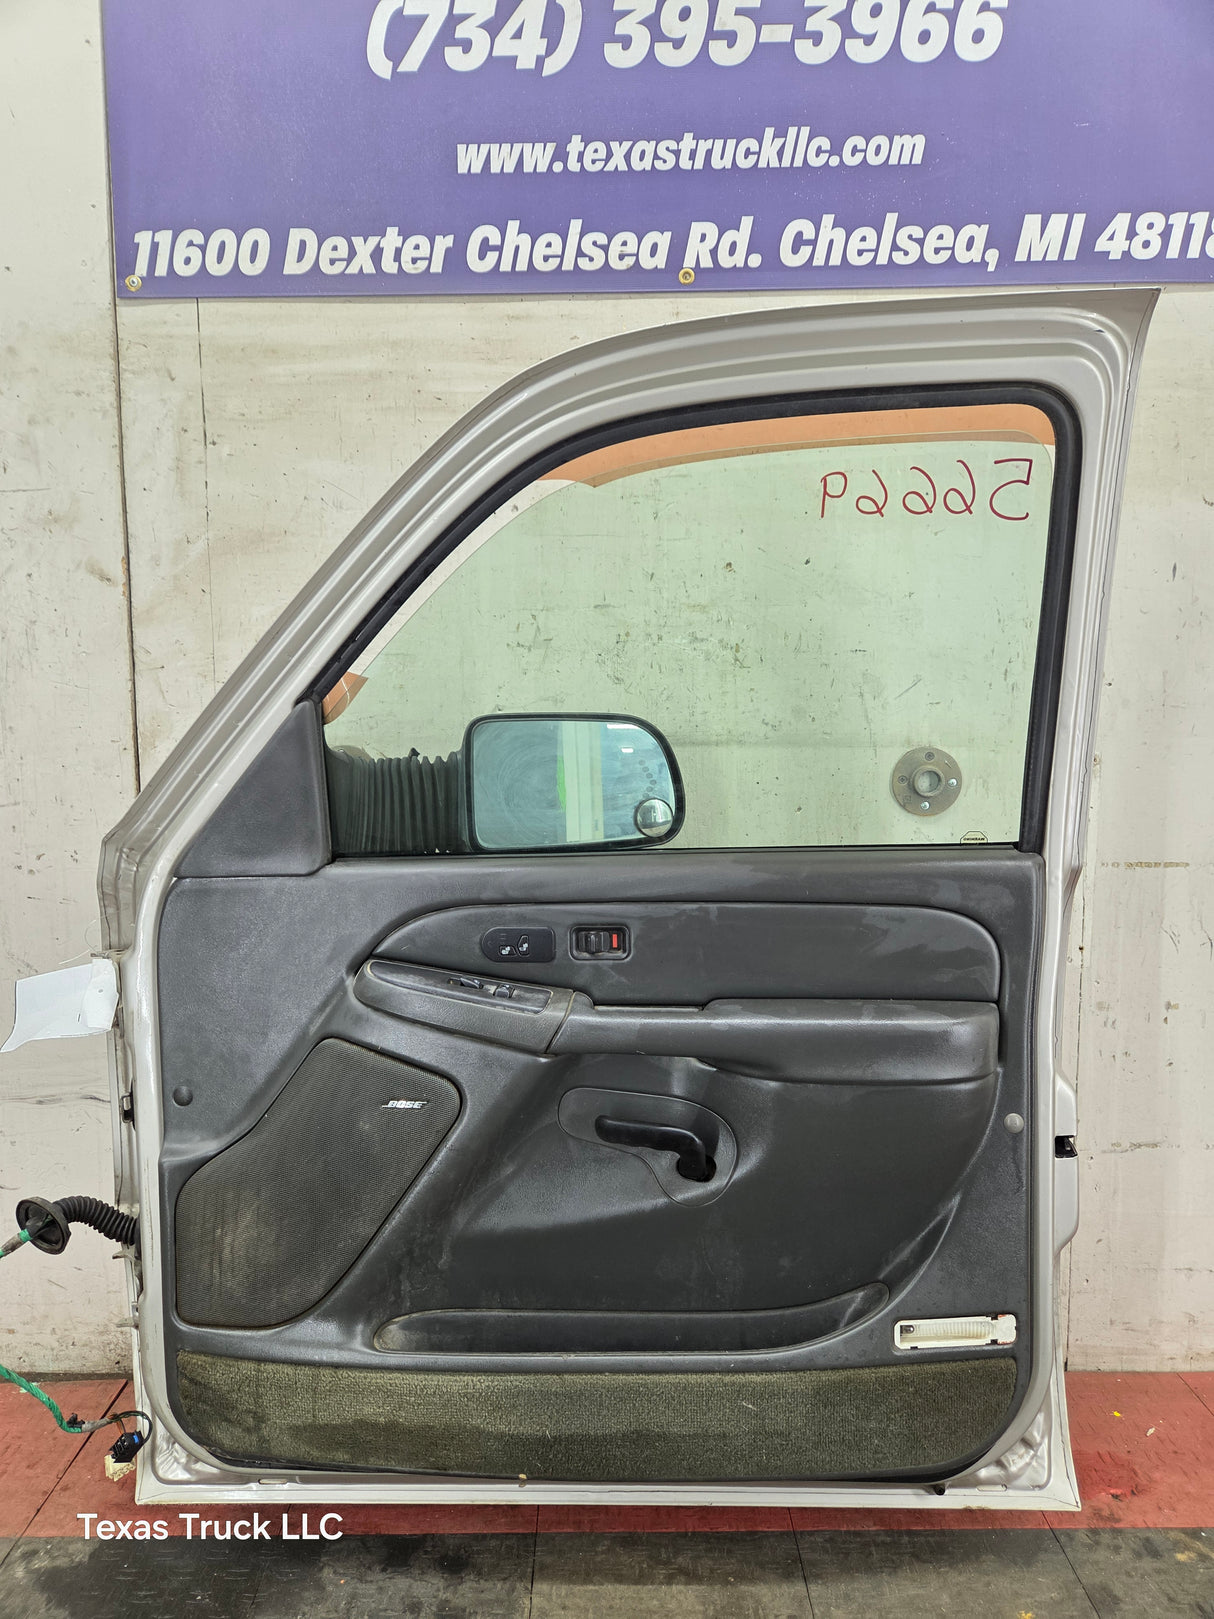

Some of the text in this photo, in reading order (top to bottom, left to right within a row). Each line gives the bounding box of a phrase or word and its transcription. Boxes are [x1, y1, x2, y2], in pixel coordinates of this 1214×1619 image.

[366, 0, 1008, 80] (734) 395-3966
[456, 127, 926, 174] www.texastruckllc.com
[132, 228, 271, 277] 11600
[282, 226, 454, 275] Dexter
[466, 219, 672, 273] Chelsea
[684, 216, 762, 269] Rd.
[779, 213, 1000, 272] Chelsea,
[1014, 213, 1087, 262] MI
[382, 1100, 427, 1109] BOSE
